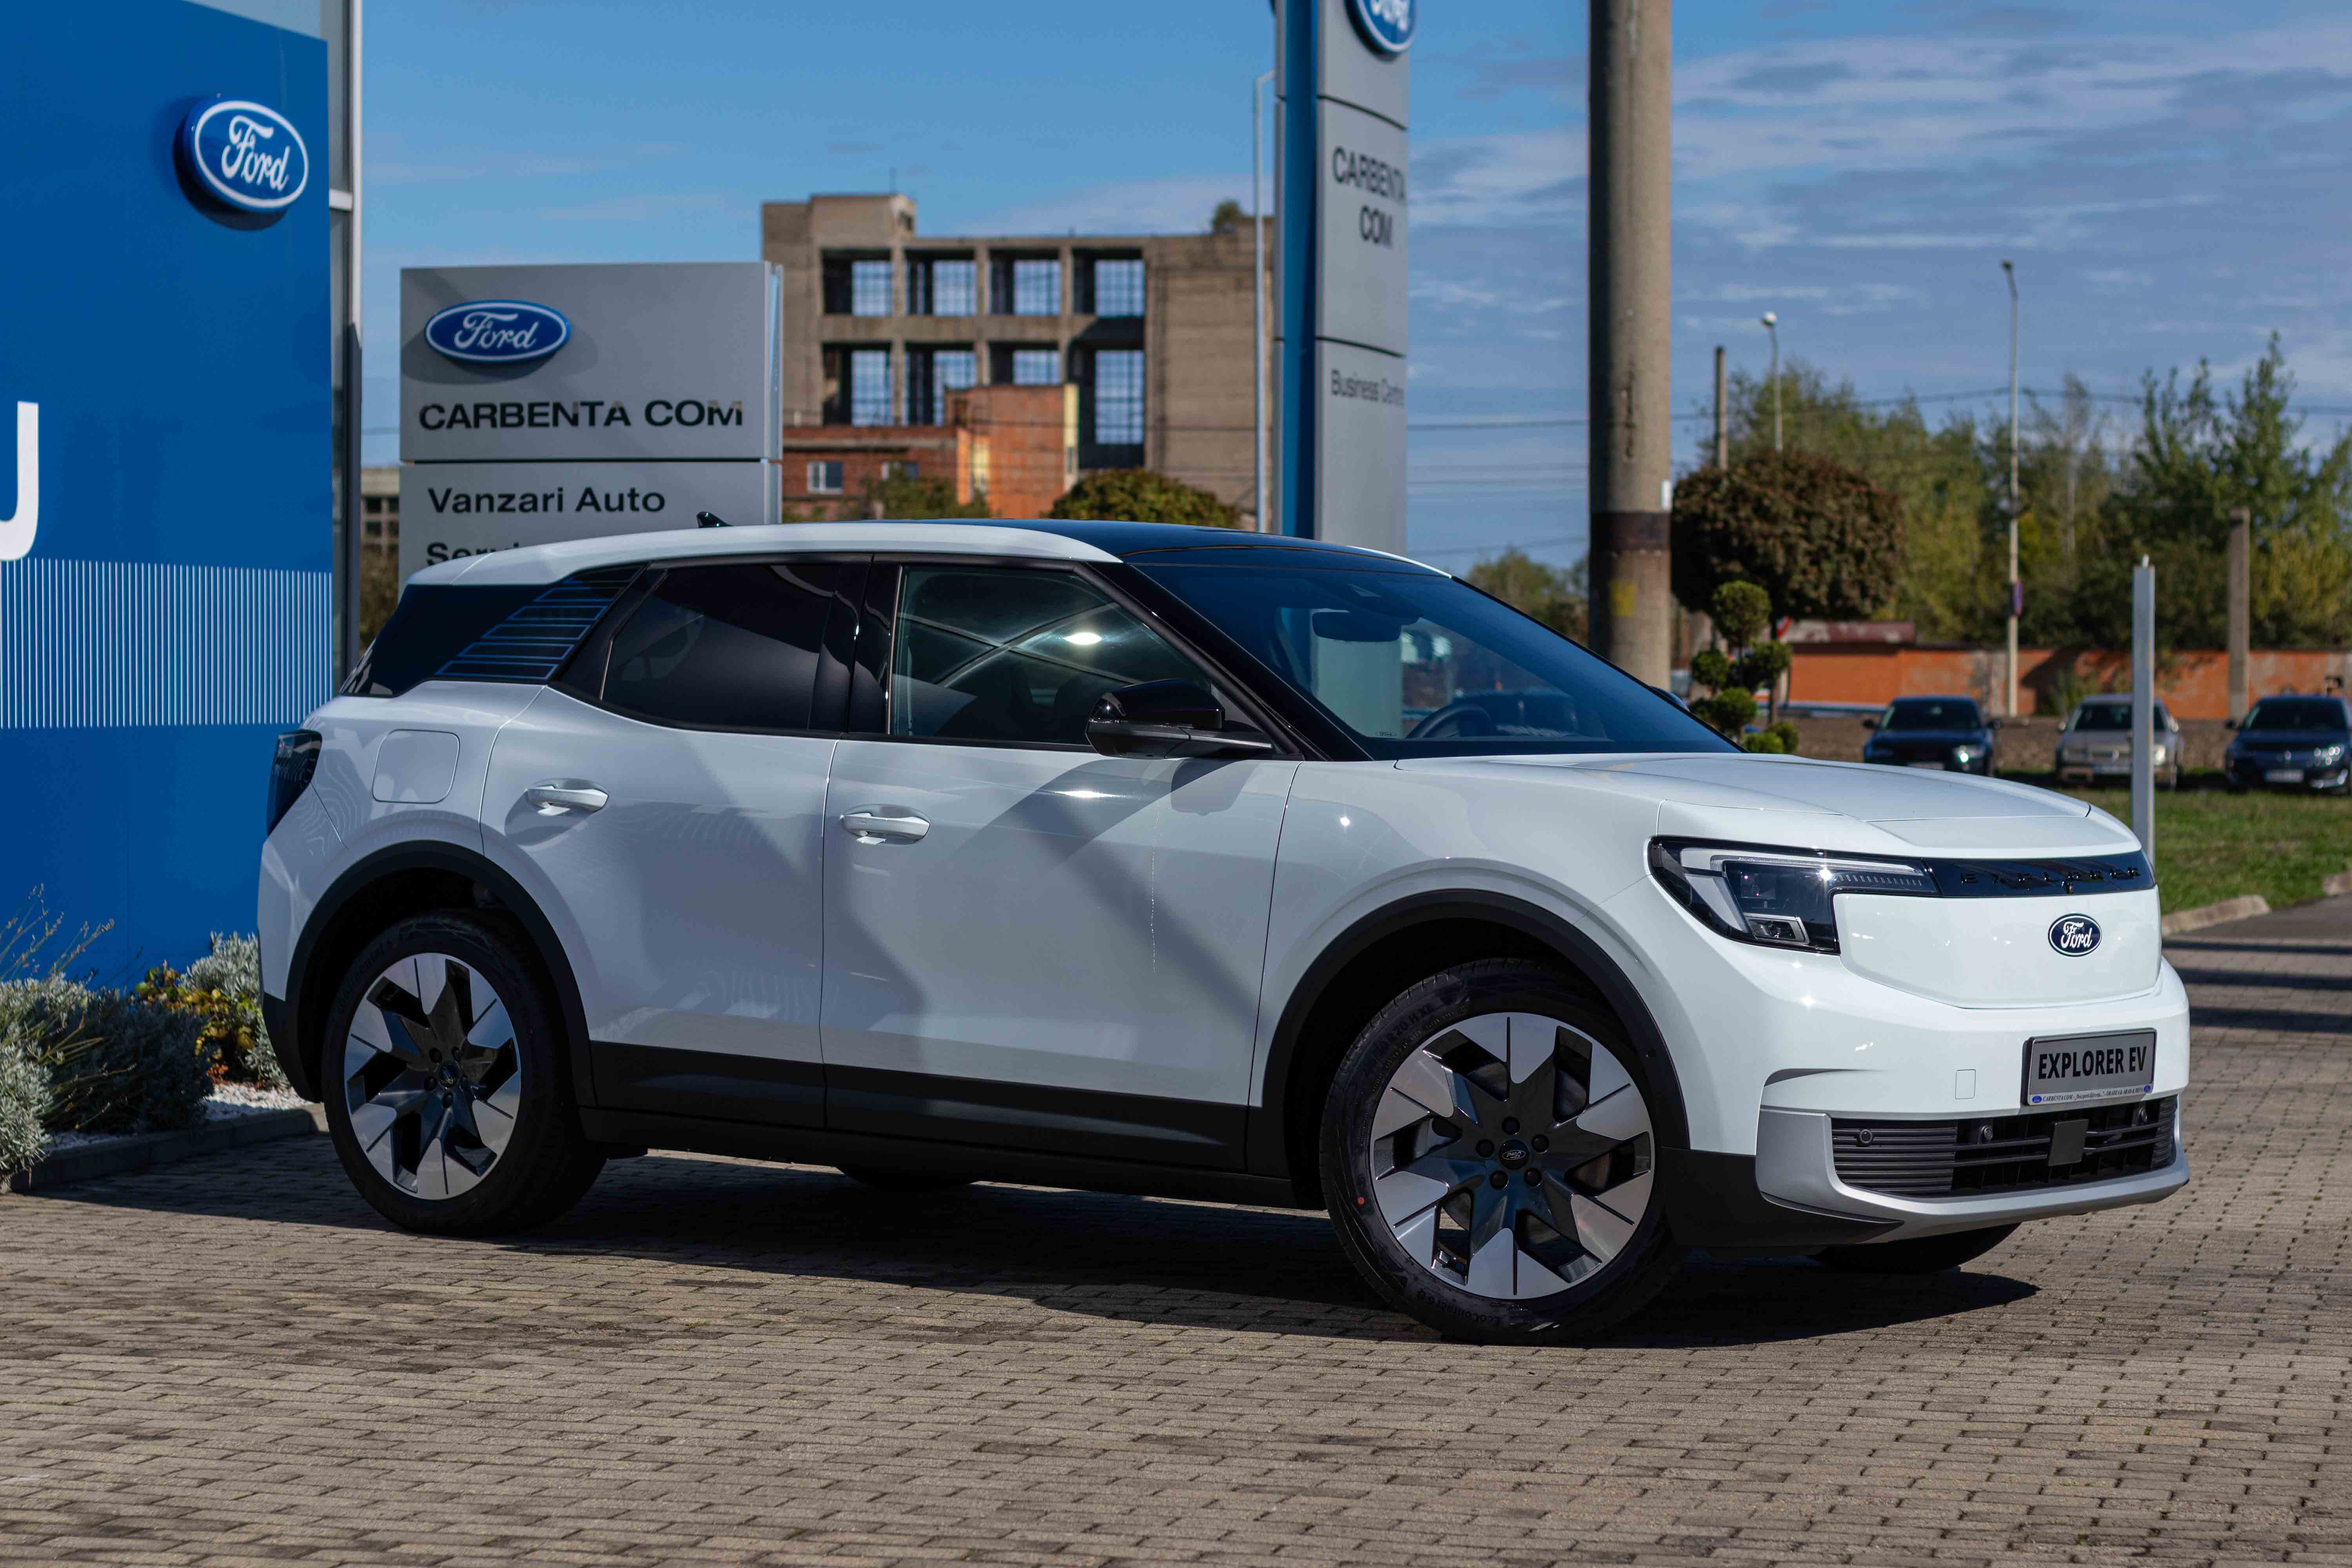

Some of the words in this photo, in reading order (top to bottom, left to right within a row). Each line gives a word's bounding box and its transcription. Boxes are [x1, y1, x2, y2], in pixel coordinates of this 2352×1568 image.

[221, 115, 290, 191] Ford
[1333, 146, 1405, 205] CARBENTA
[1359, 205, 1393, 249] COM
[454, 310, 537, 348] Ford
[1331, 368, 1379, 403] Business
[418, 401, 630, 430] CARBENTA
[644, 400, 742, 426] COM
[428, 486, 564, 513] Vanzari
[575, 487, 665, 513] Auto
[2060, 921, 2092, 948] Ford
[2038, 1048, 2125, 1079] EXPLORER
[2129, 1046, 2147, 1072] EV
